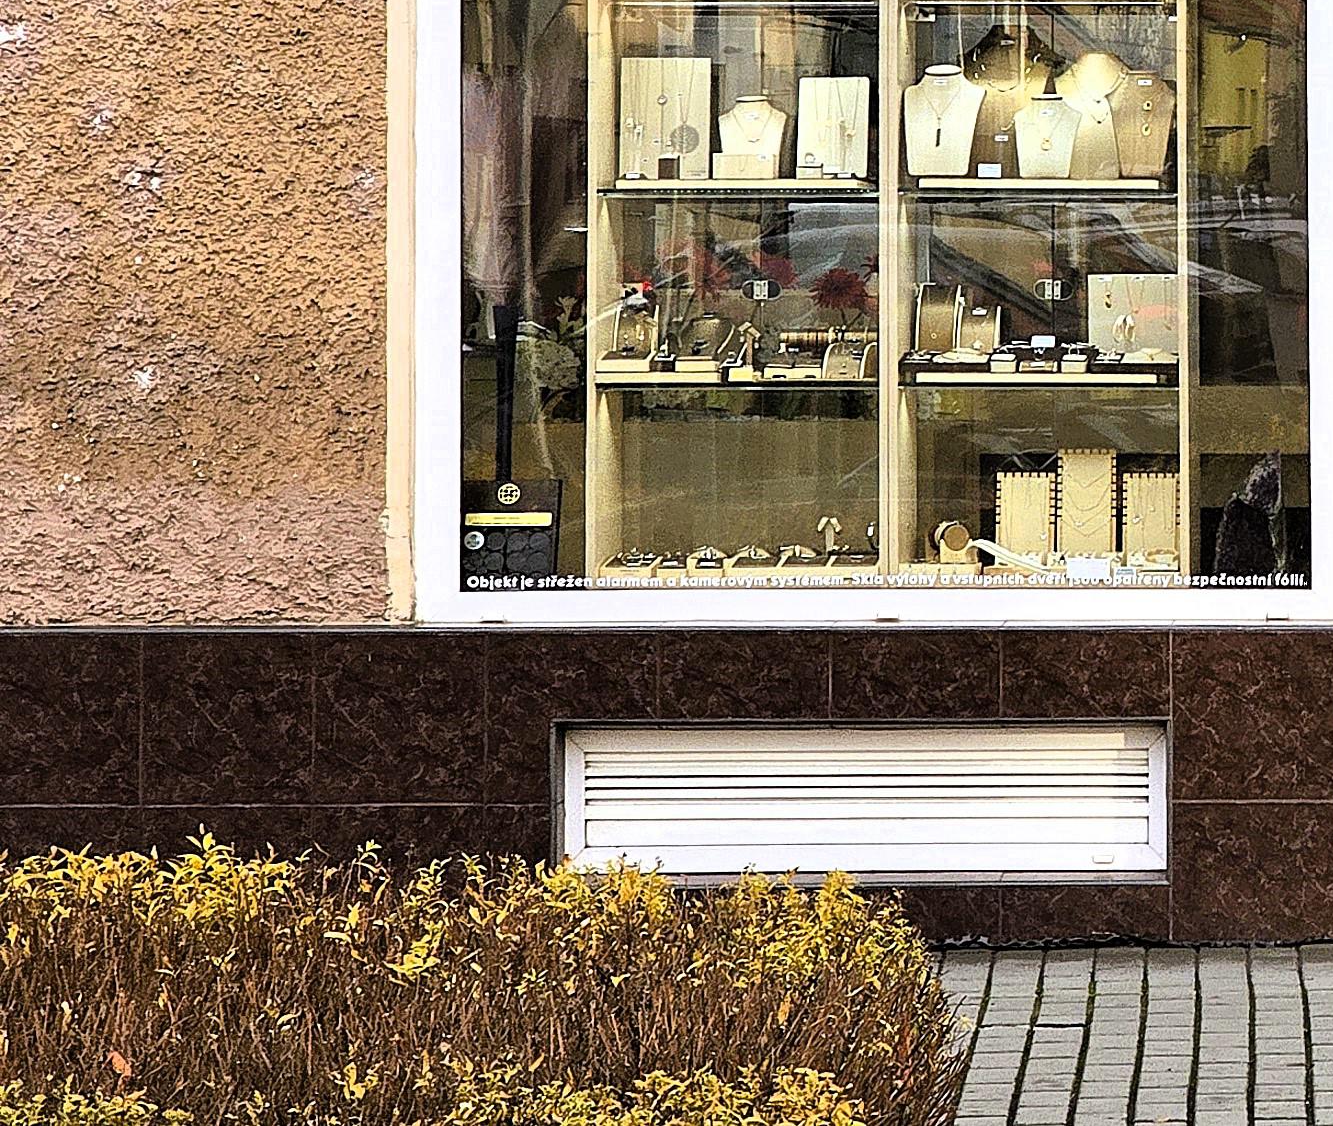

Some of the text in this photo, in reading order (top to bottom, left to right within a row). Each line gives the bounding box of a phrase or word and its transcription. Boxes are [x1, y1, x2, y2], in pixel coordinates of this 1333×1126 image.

[466, 575, 519, 590] Objekt
[520, 574, 534, 590] je
[537, 575, 592, 588] střežen
[596, 575, 662, 588] alarmem
[667, 577, 675, 587] a
[680, 575, 767, 589] kamerovým
[852, 573, 884, 586] Skla
[941, 575, 949, 586] a
[1173, 573, 1271, 587] bezpečnostní
